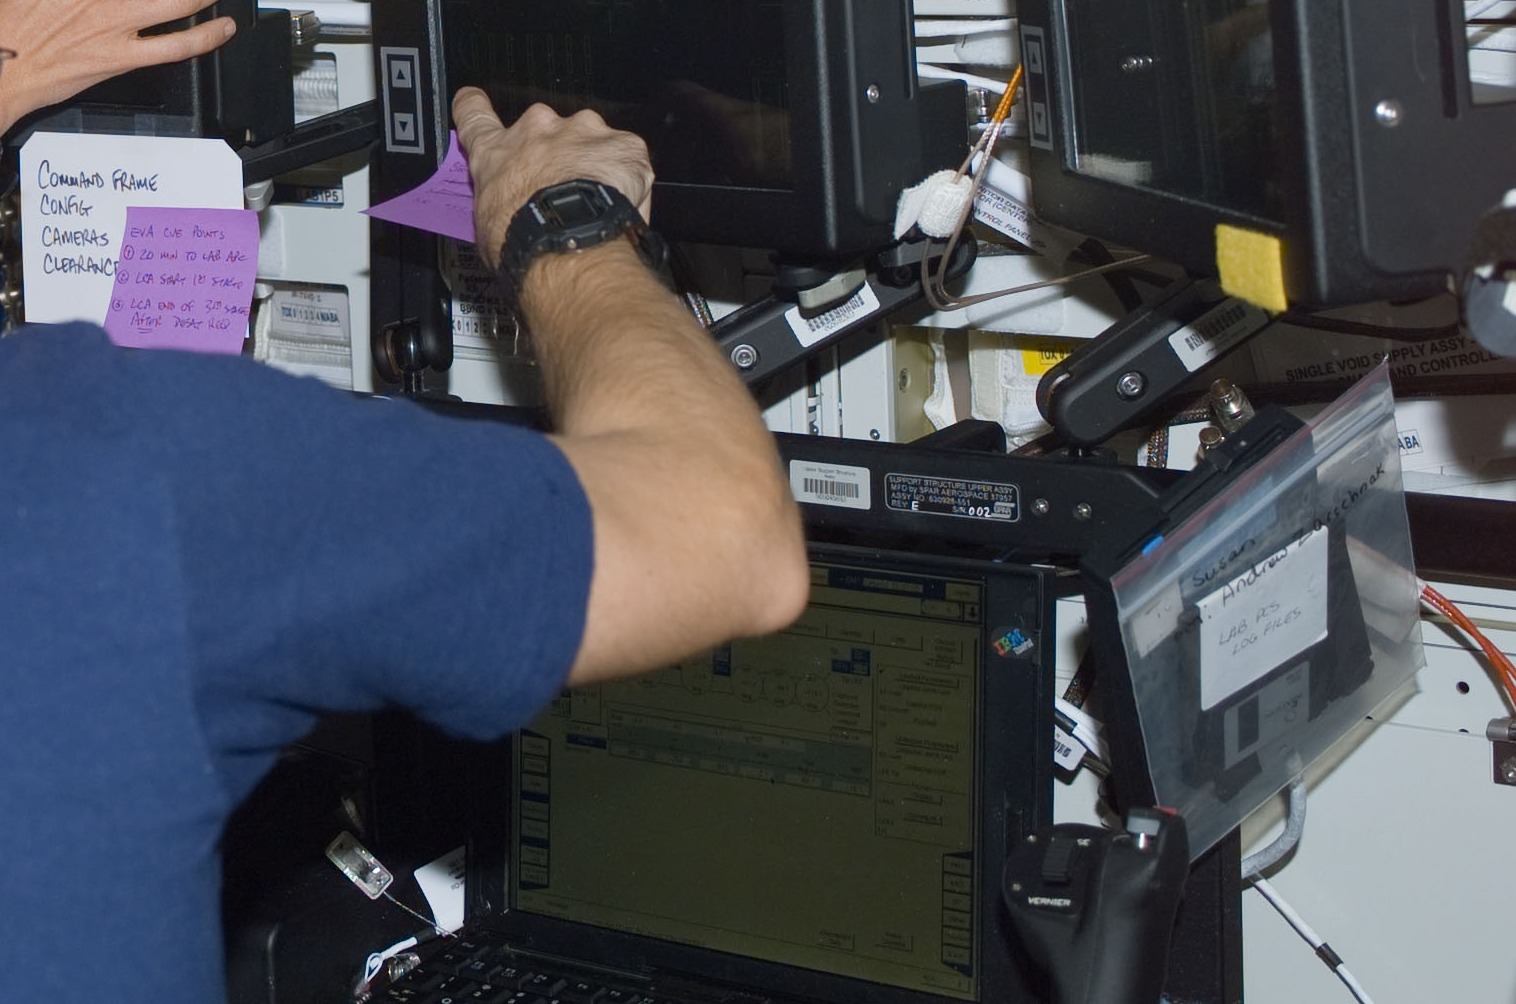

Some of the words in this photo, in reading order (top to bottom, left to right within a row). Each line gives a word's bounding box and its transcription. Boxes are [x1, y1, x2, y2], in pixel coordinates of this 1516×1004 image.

[37, 159, 105, 190] COMMAND
[111, 168, 159, 192] FRAME
[39, 194, 93, 218] CONFIG
[41, 225, 110, 249] CAMERAS
[130, 224, 154, 238] EVA
[139, 250, 155, 261] 20
[130, 297, 151, 310] LCA
[1285, 363, 1335, 383] SINGLE
[1334, 354, 1371, 374] VOID
[1430, 336, 1467, 355] ASSY
[889, 475, 922, 486] SUPPORT
[923, 478, 966, 490] STRUCTURE
[968, 482, 993, 493] UPPER
[993, 485, 1014, 495] ASSY
[890, 484, 908, 492] MFD
[919, 486, 940, 496] SPAR
[940, 488, 989, 500] AEROSPACE
[891, 492, 911, 501] ASSY
[911, 500, 920, 511] E
[968, 506, 992, 518] 002
[1191, 536, 1256, 588] Susan
[1222, 546, 1289, 607] Andrew
[1219, 618, 1249, 646] LAB
[1263, 607, 1302, 636] FILES
[1027, 895, 1073, 908] VERNIER
